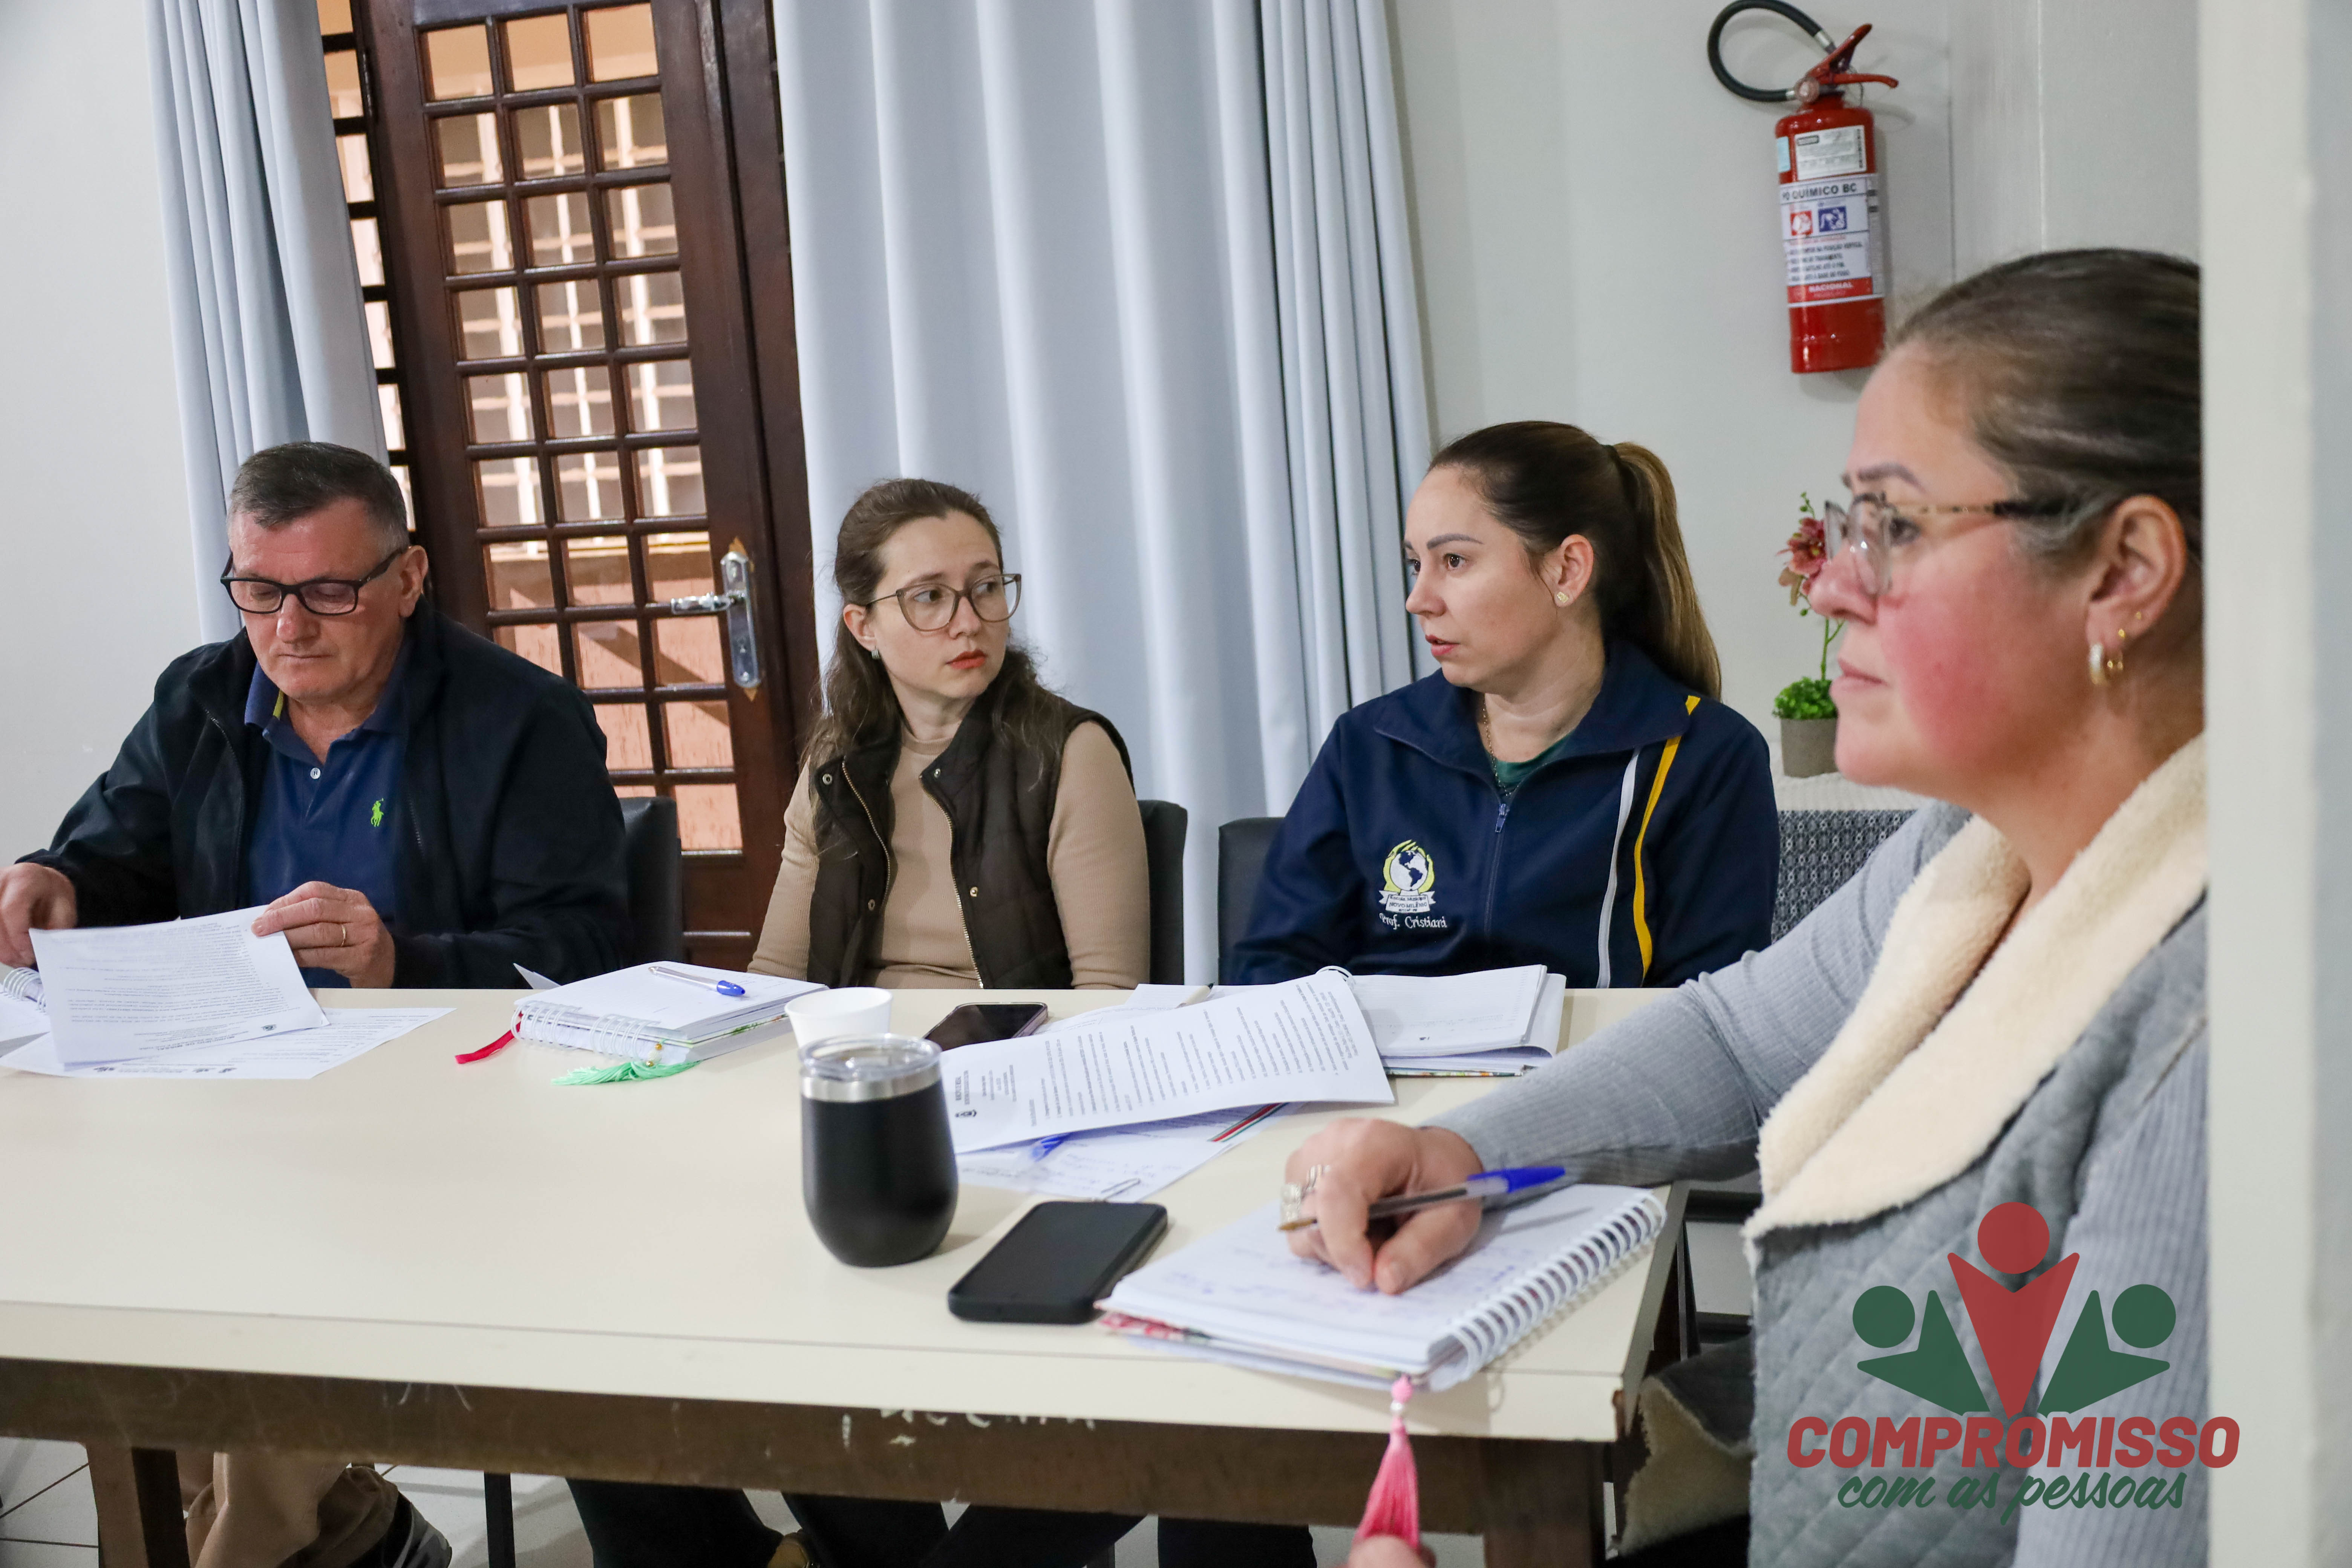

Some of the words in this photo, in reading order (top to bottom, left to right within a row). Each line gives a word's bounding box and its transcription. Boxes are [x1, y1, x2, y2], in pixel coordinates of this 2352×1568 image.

[1792, 185, 1839, 199] QUÍMICO
[1843, 183, 1857, 193] BC
[1379, 913, 1400, 930] Prof.
[1405, 916, 1447, 929] Cristiani
